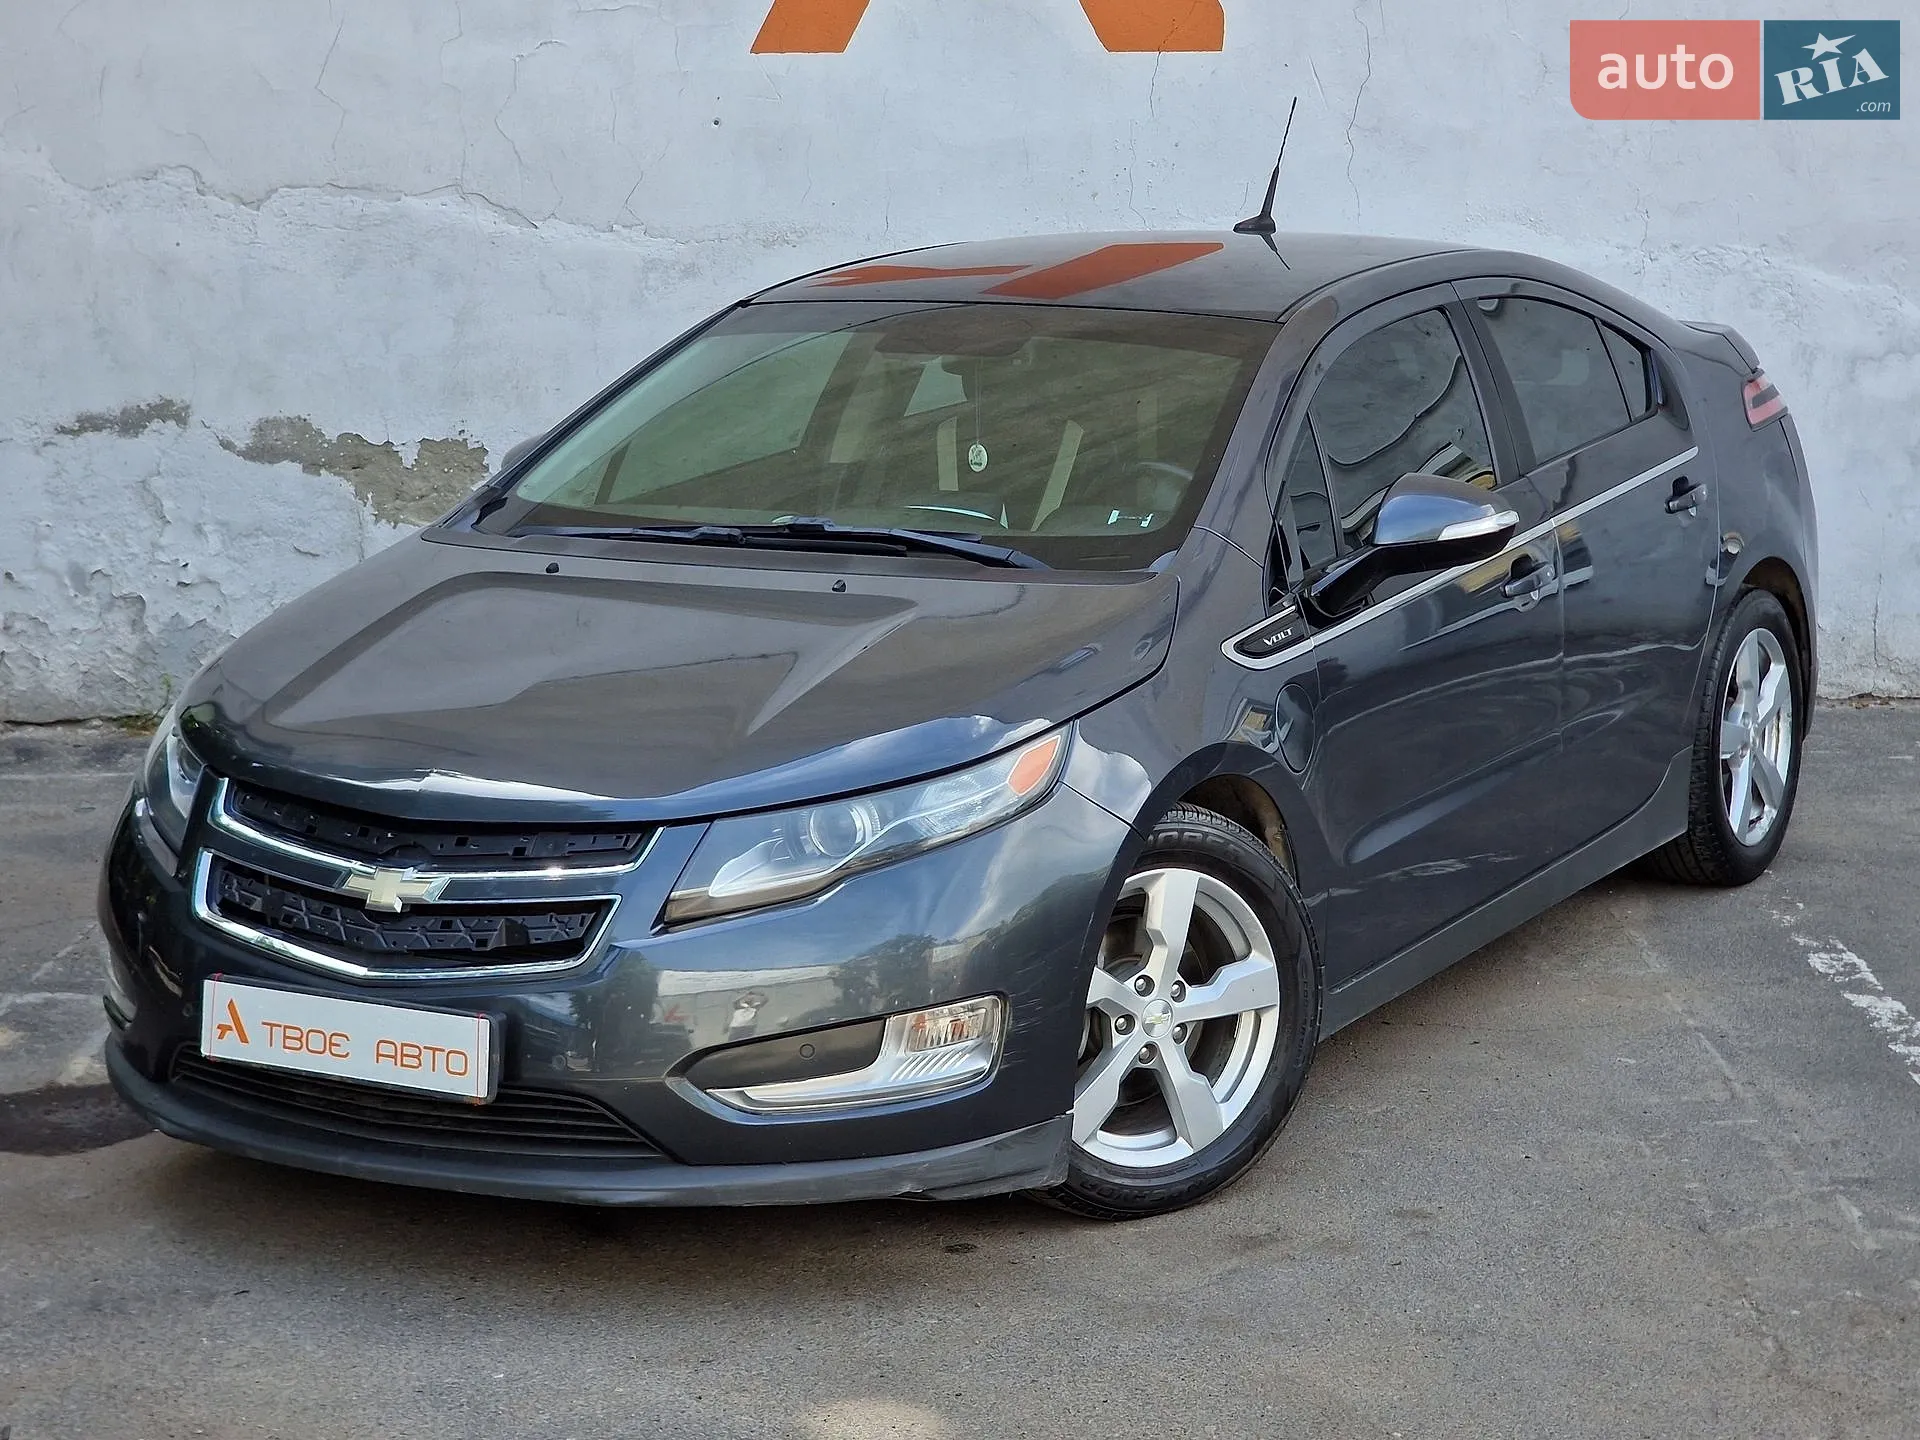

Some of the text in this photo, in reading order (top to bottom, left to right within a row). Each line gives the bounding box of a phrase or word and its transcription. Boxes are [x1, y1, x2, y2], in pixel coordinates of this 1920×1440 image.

[1263, 627, 1294, 646] VOLT
[261, 1020, 350, 1059] ТВОЄ
[375, 1039, 469, 1077] АВТО
